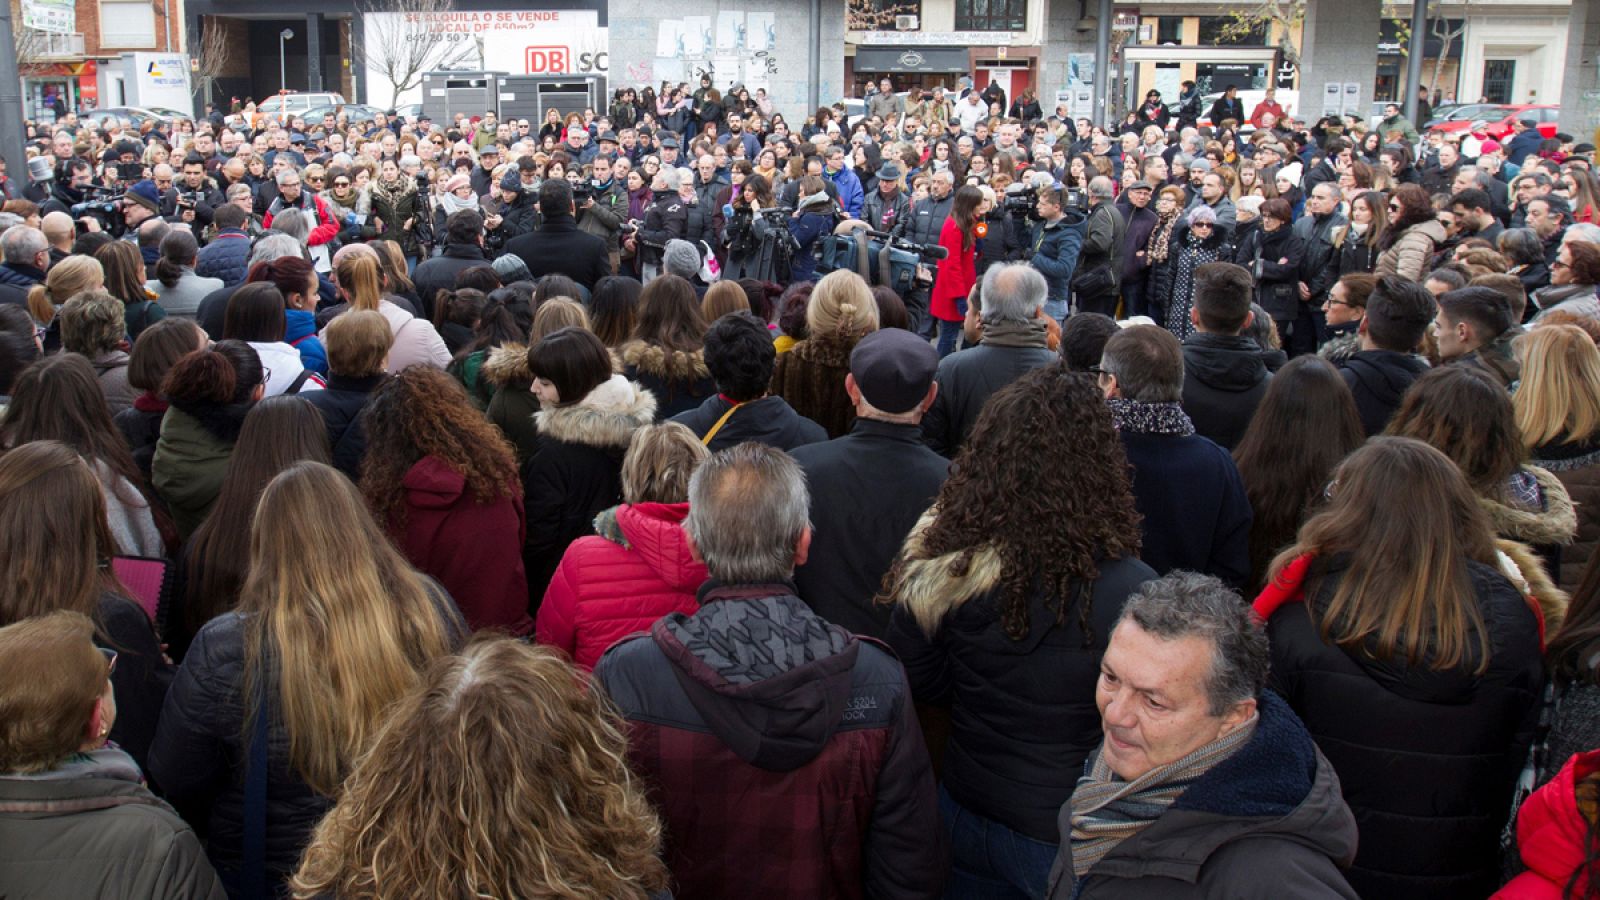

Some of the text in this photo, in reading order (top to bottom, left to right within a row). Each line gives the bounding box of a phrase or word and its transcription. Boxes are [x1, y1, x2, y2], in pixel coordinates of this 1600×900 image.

[425, 12, 480, 21] ALQUILA
[483, 12, 493, 21] O
[496, 12, 512, 21] SE
[516, 11, 559, 21] VENDE
[428, 23, 470, 32] LOCAL
[531, 51, 564, 72] DB
[579, 51, 608, 72] SC
